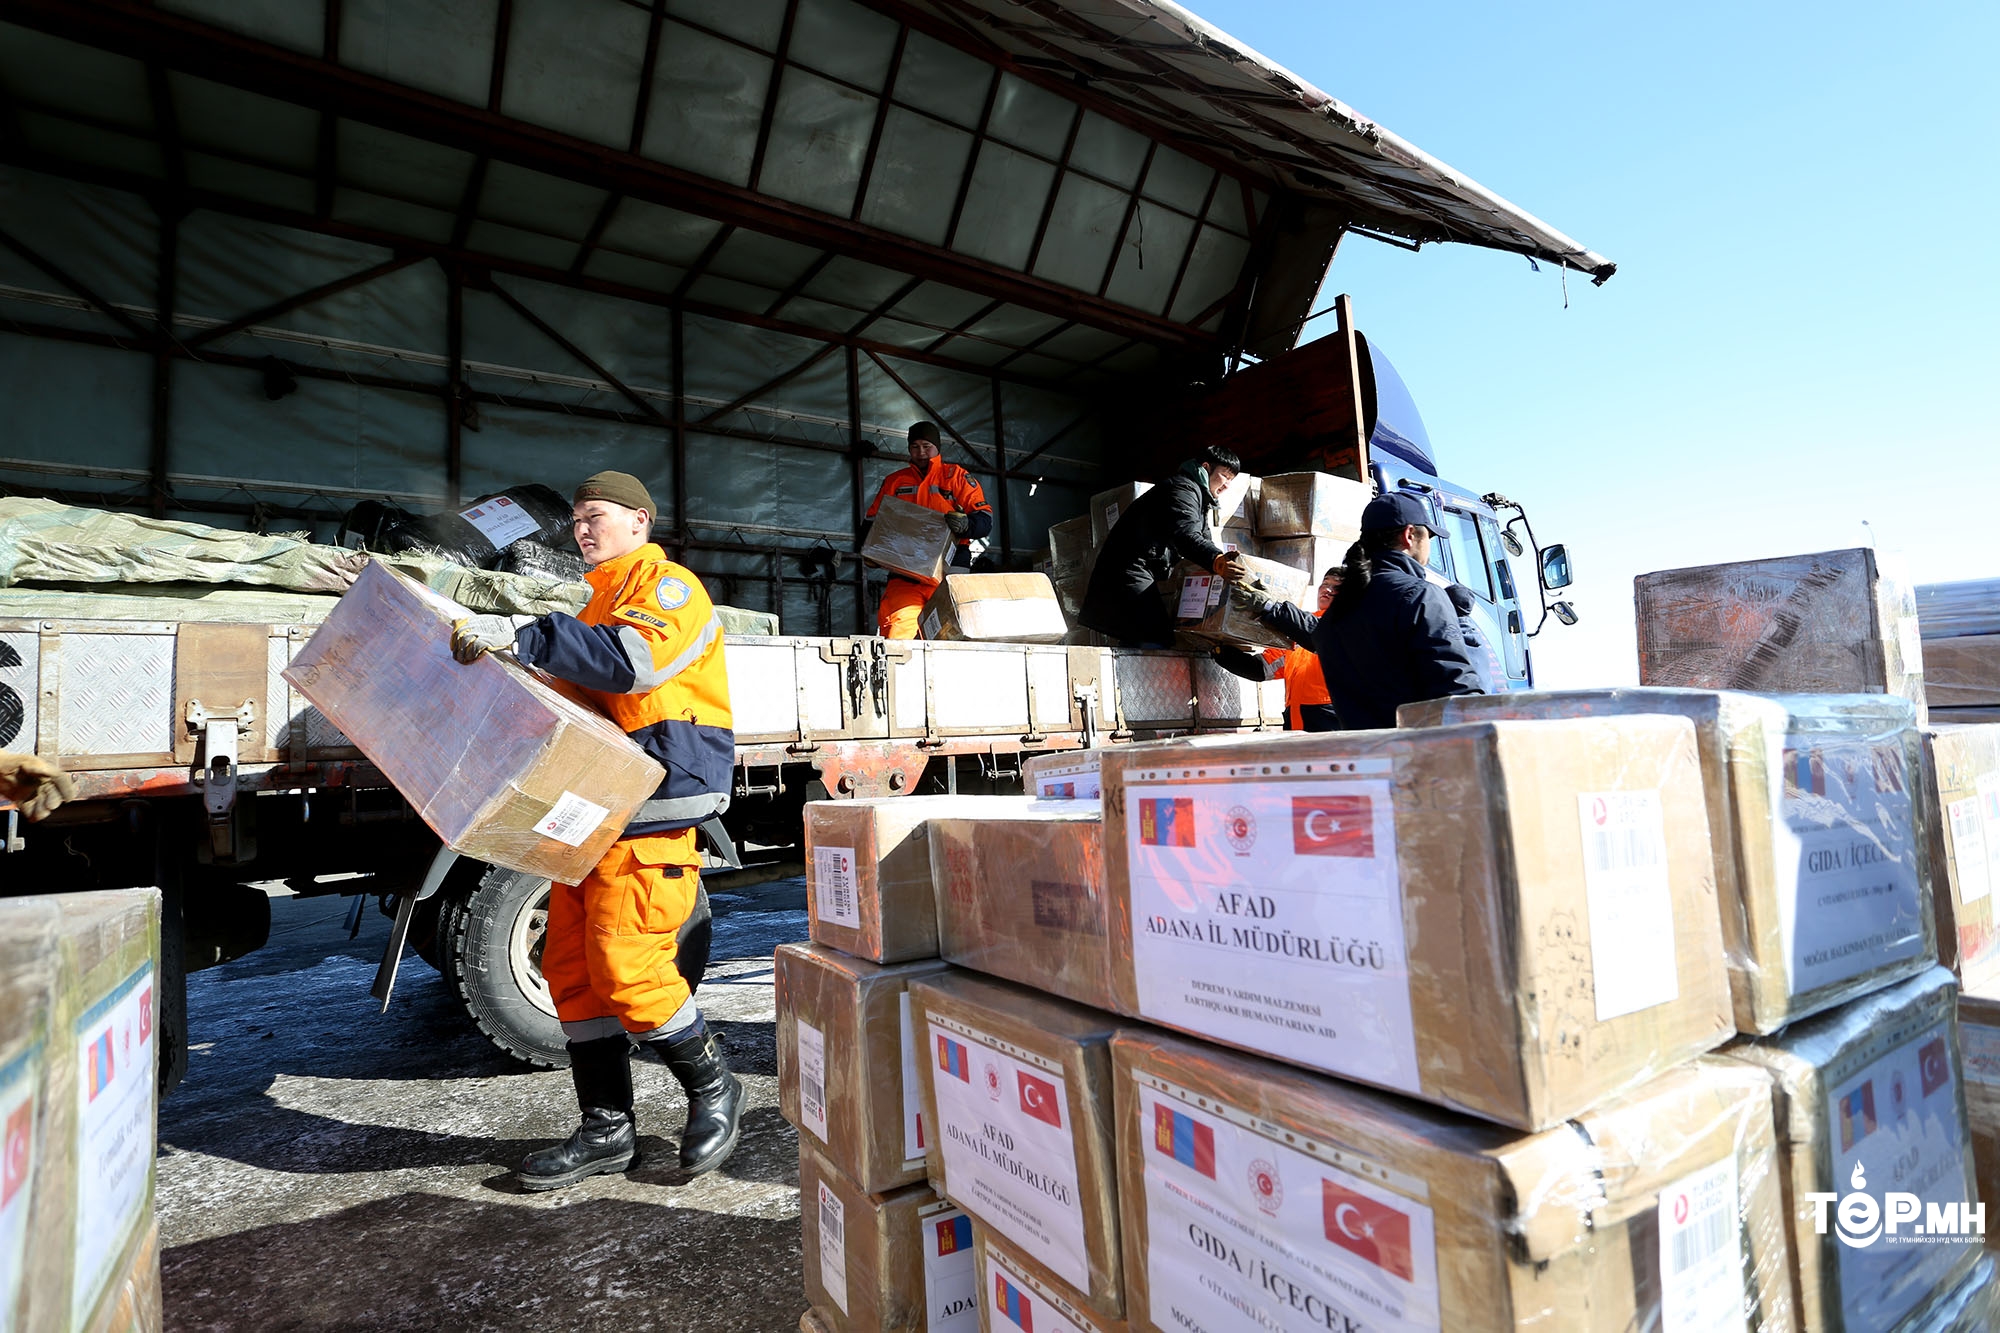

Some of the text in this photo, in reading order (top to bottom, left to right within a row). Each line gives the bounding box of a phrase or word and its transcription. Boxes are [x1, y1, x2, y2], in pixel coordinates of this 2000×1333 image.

[1809, 849, 1842, 873] GIDA
[1851, 841, 1892, 869] İÇEC
[1216, 892, 1276, 919] AFAD
[1146, 915, 1385, 970] ADANA İL MÜDÜRLÜĞÜ
[1184, 994, 1337, 1040] EARTHQUAKE HUMANITARIAN AID
[1191, 980, 1322, 1017] DEPREM YARDIM MALZEMESİ
[983, 1122, 1014, 1151] AFAD
[946, 1123, 1071, 1206] ADANA İL MÜDÜRLÜĞÜ
[1189, 1223, 1243, 1273] GIDA
[1248, 1259, 1254, 1280] /
